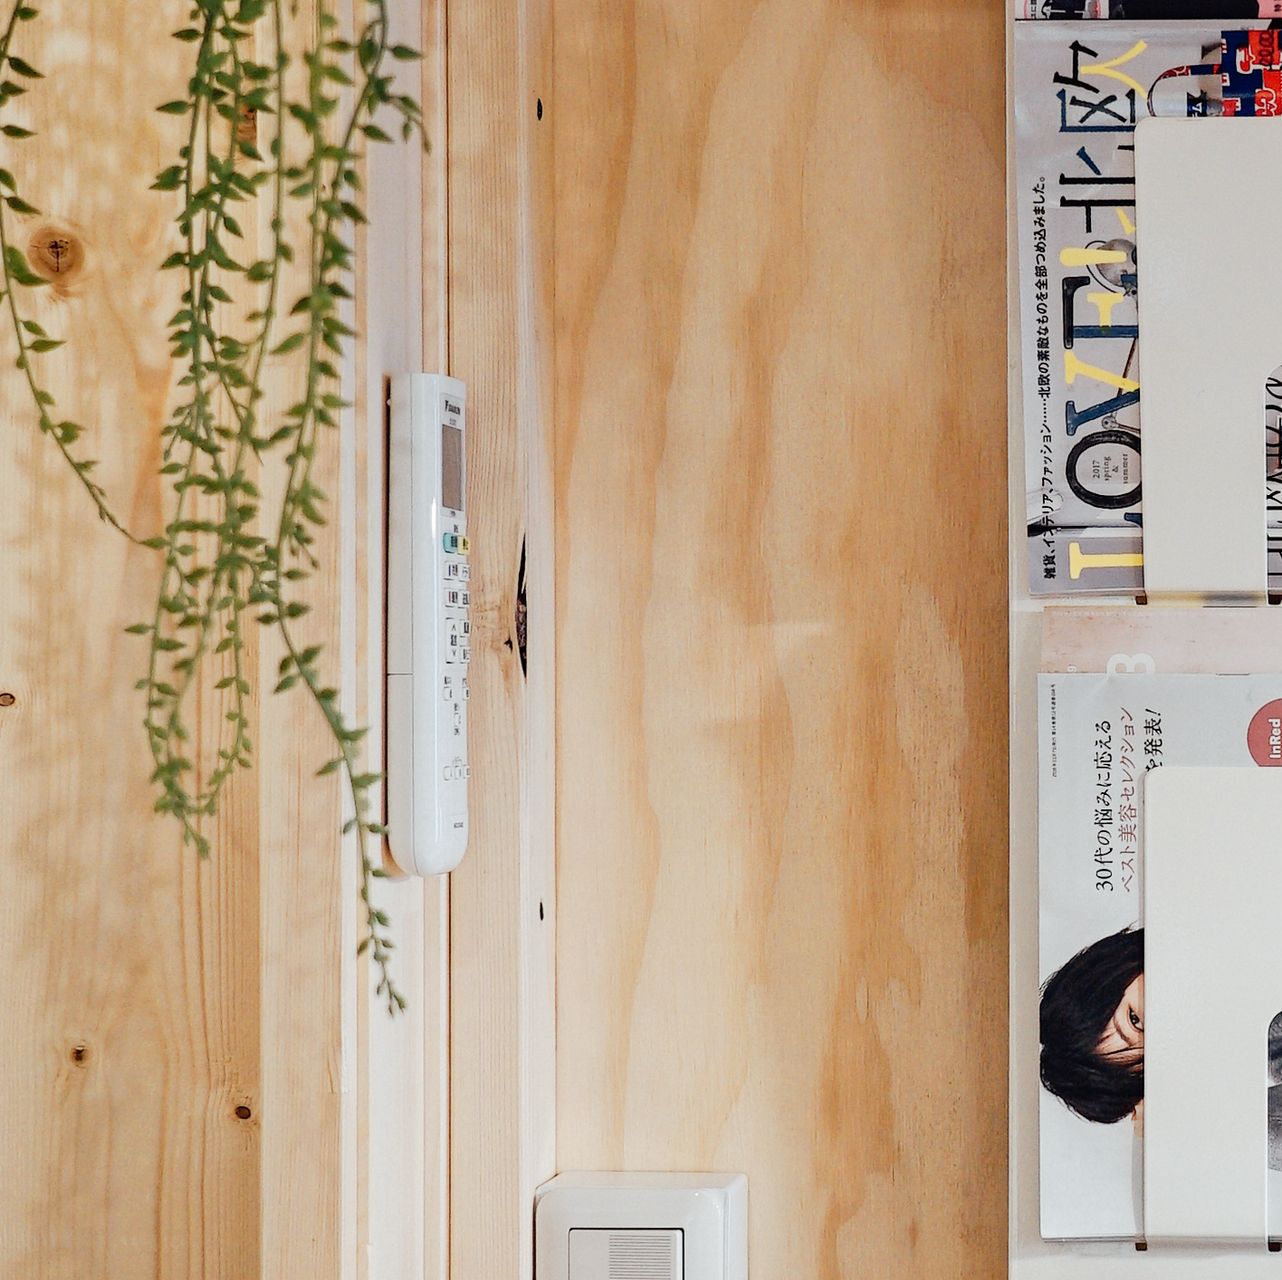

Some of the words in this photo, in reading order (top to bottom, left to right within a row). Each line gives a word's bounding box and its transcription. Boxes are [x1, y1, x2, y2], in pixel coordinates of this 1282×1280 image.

[1092, 460, 1100, 478] 2017
[1268, 718, 1282, 760] InRed
[1093, 720, 1114, 893] 30代の悩みに応える
[1117, 707, 1138, 894] ベスト美容セレクション
